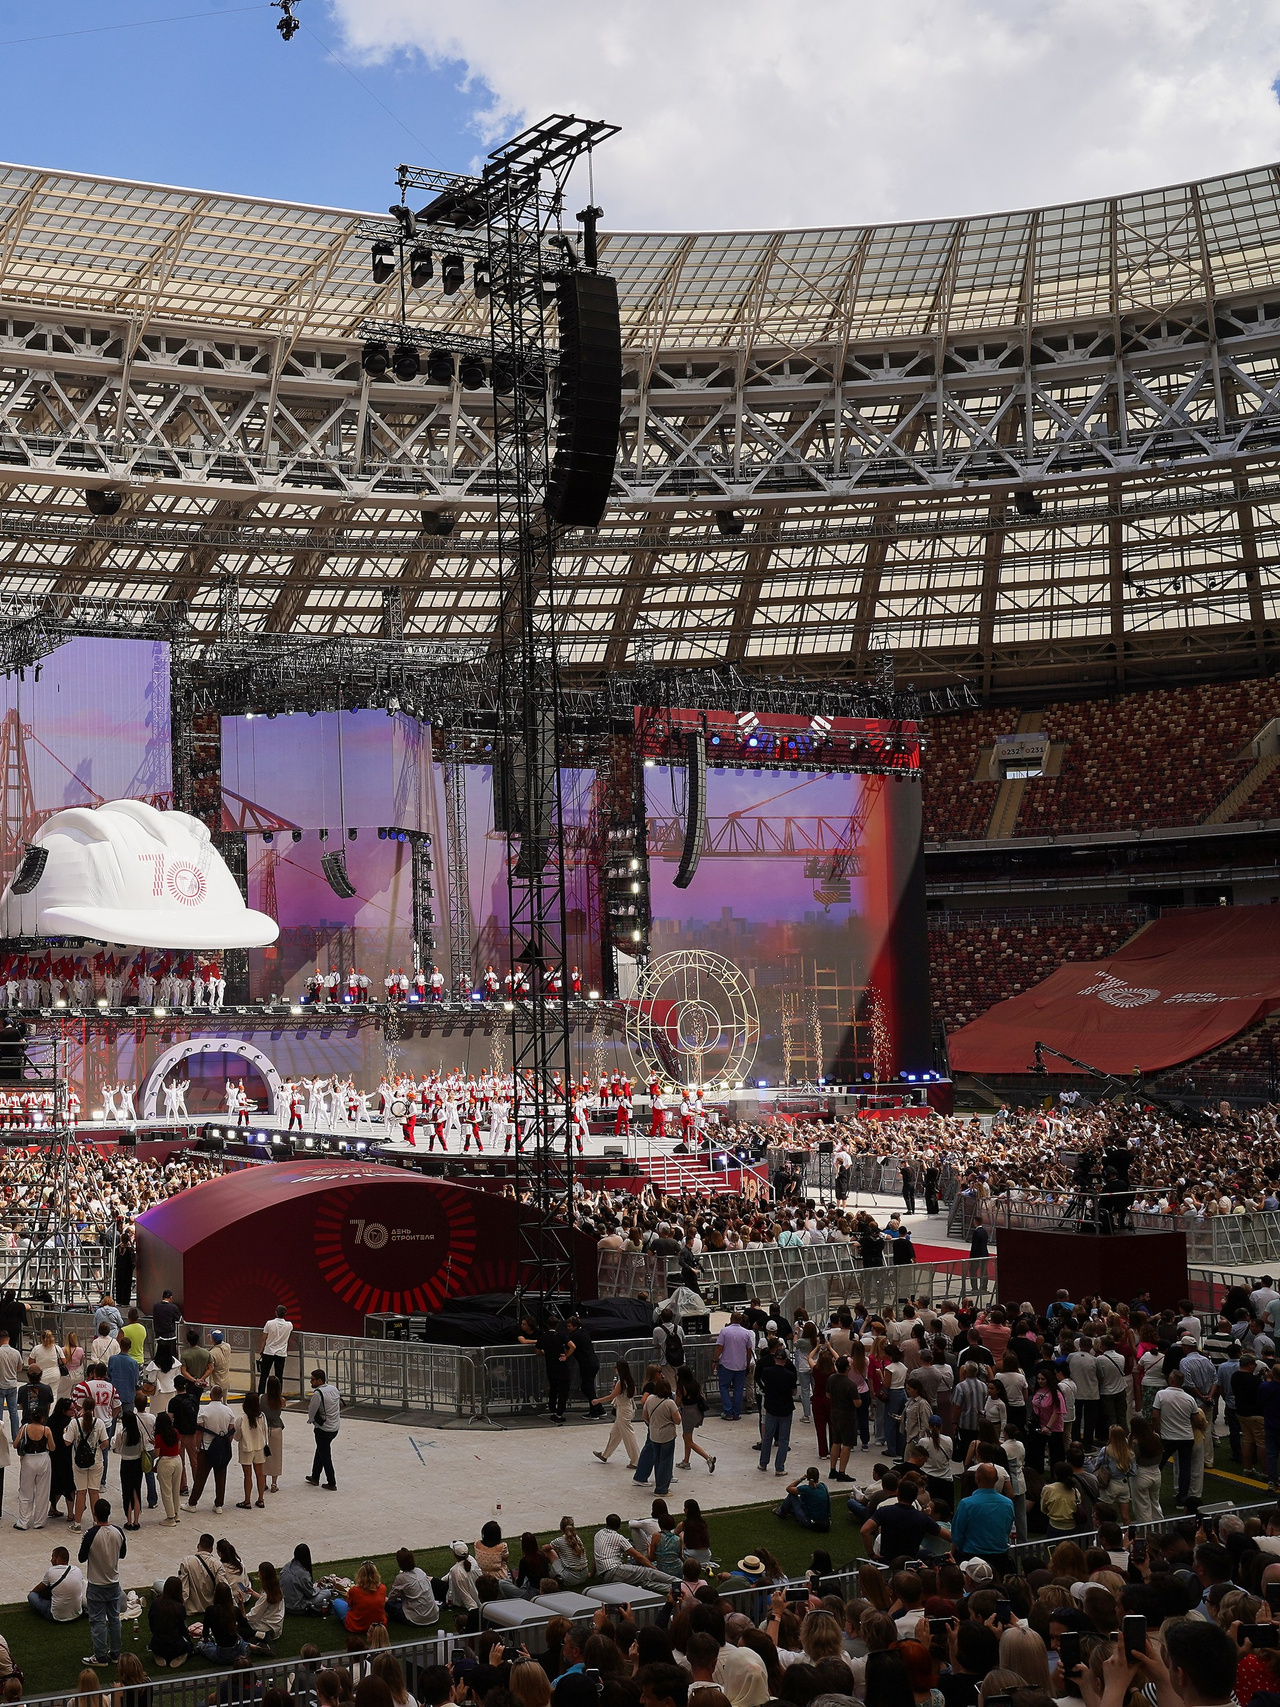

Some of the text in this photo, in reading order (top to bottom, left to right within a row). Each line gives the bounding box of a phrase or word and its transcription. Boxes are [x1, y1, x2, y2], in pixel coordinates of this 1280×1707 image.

[138, 853, 207, 906] 70
[349, 1219, 388, 1249] 70
[95, 1391, 109, 1406] 12
